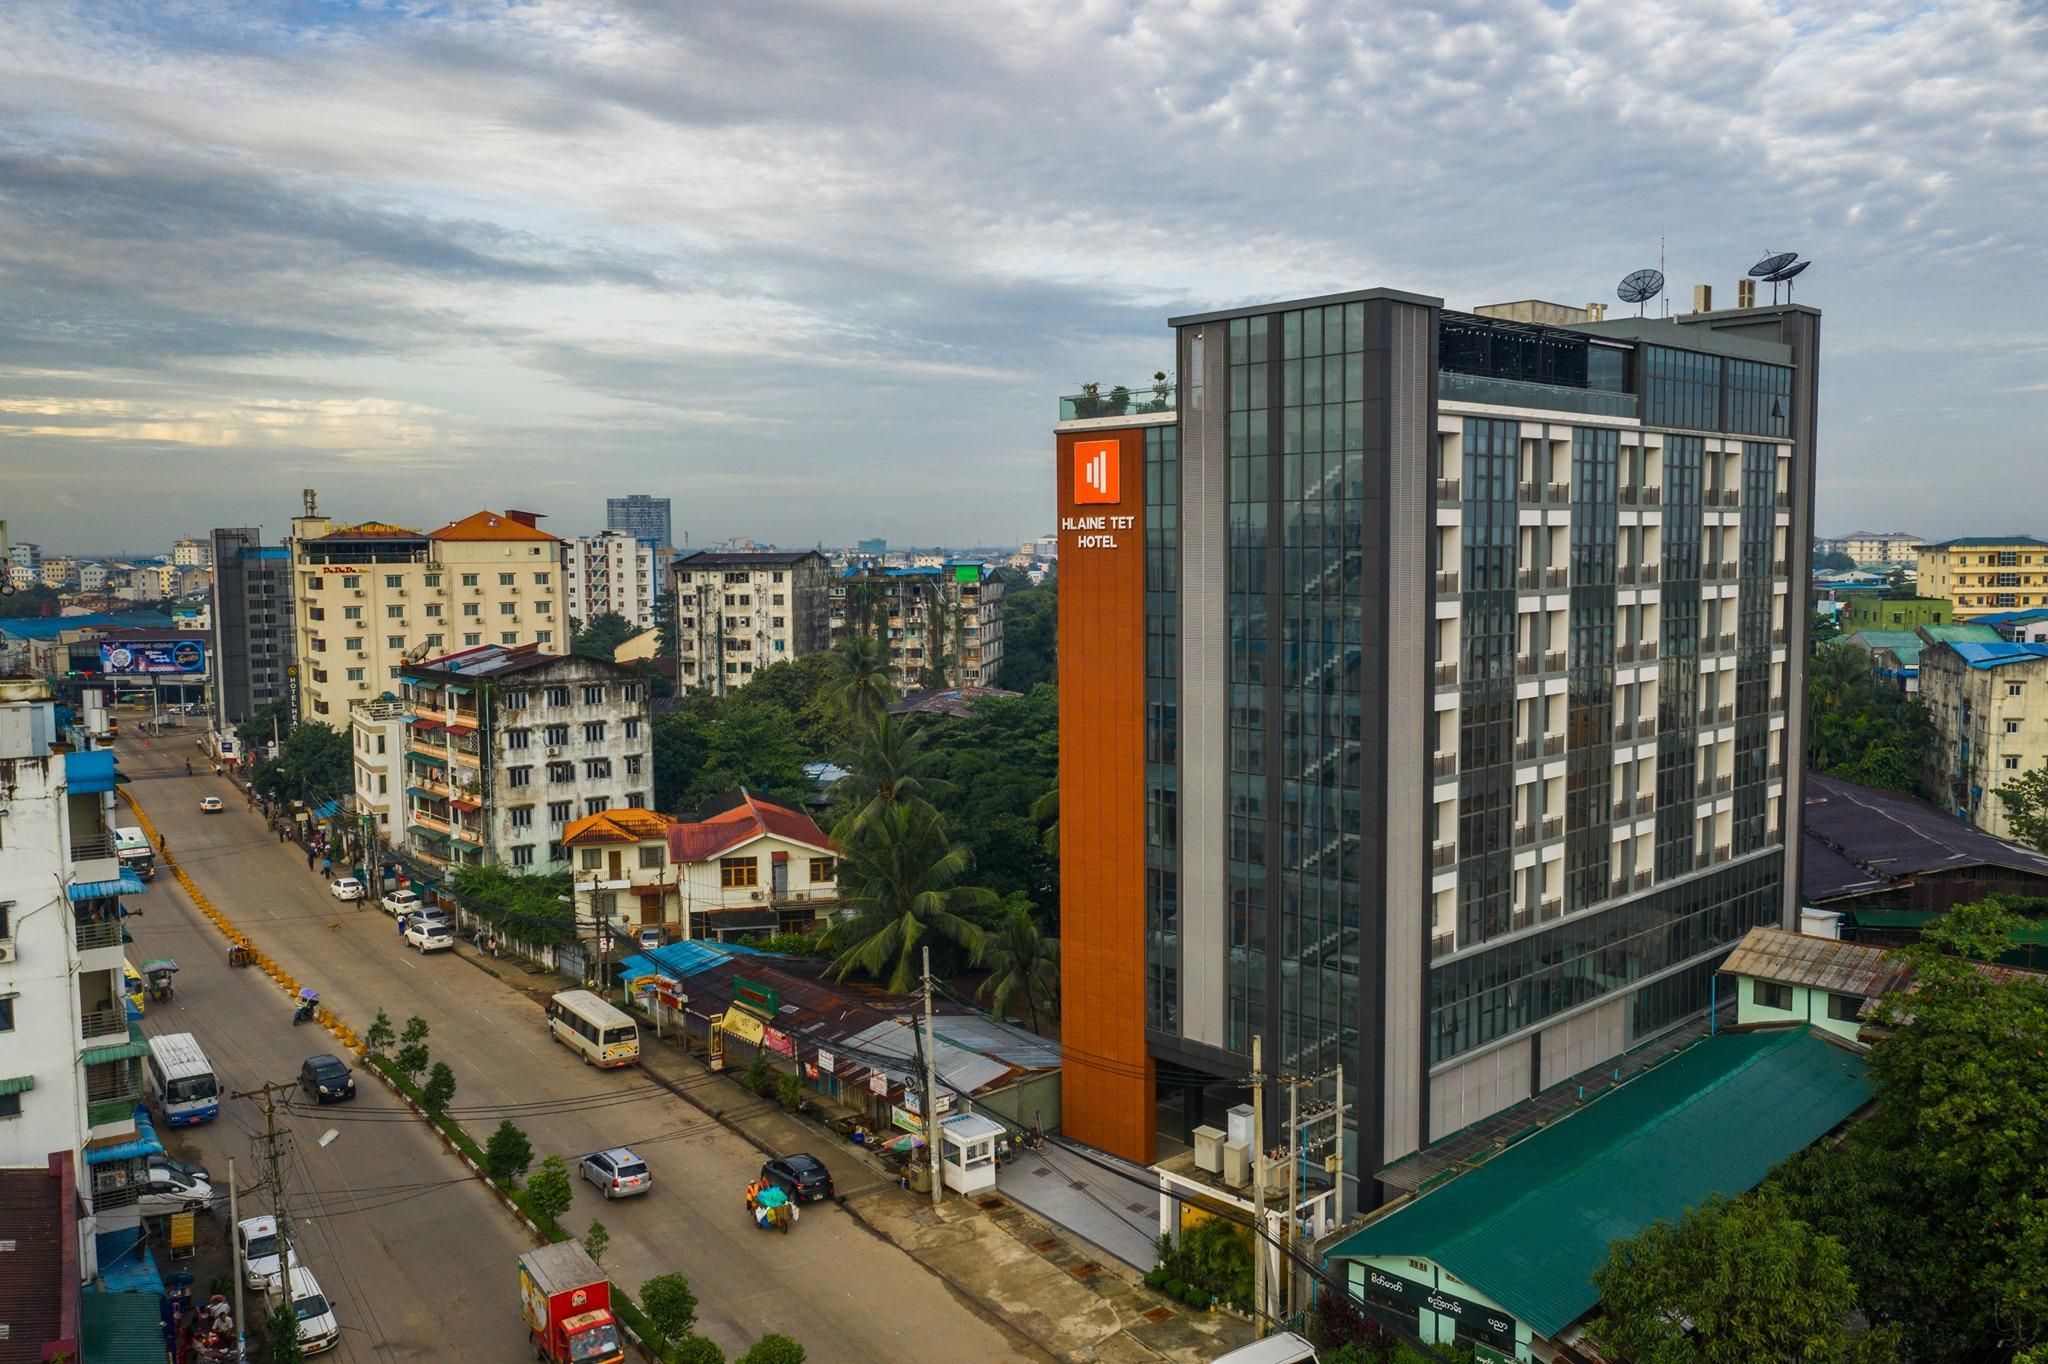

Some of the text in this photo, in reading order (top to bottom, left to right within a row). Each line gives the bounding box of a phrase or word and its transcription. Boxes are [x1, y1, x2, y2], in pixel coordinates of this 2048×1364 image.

[361, 524, 400, 533] HEAVEN
[1062, 516, 1134, 530] HLAINE TET
[1078, 535, 1117, 548] HOTEL
